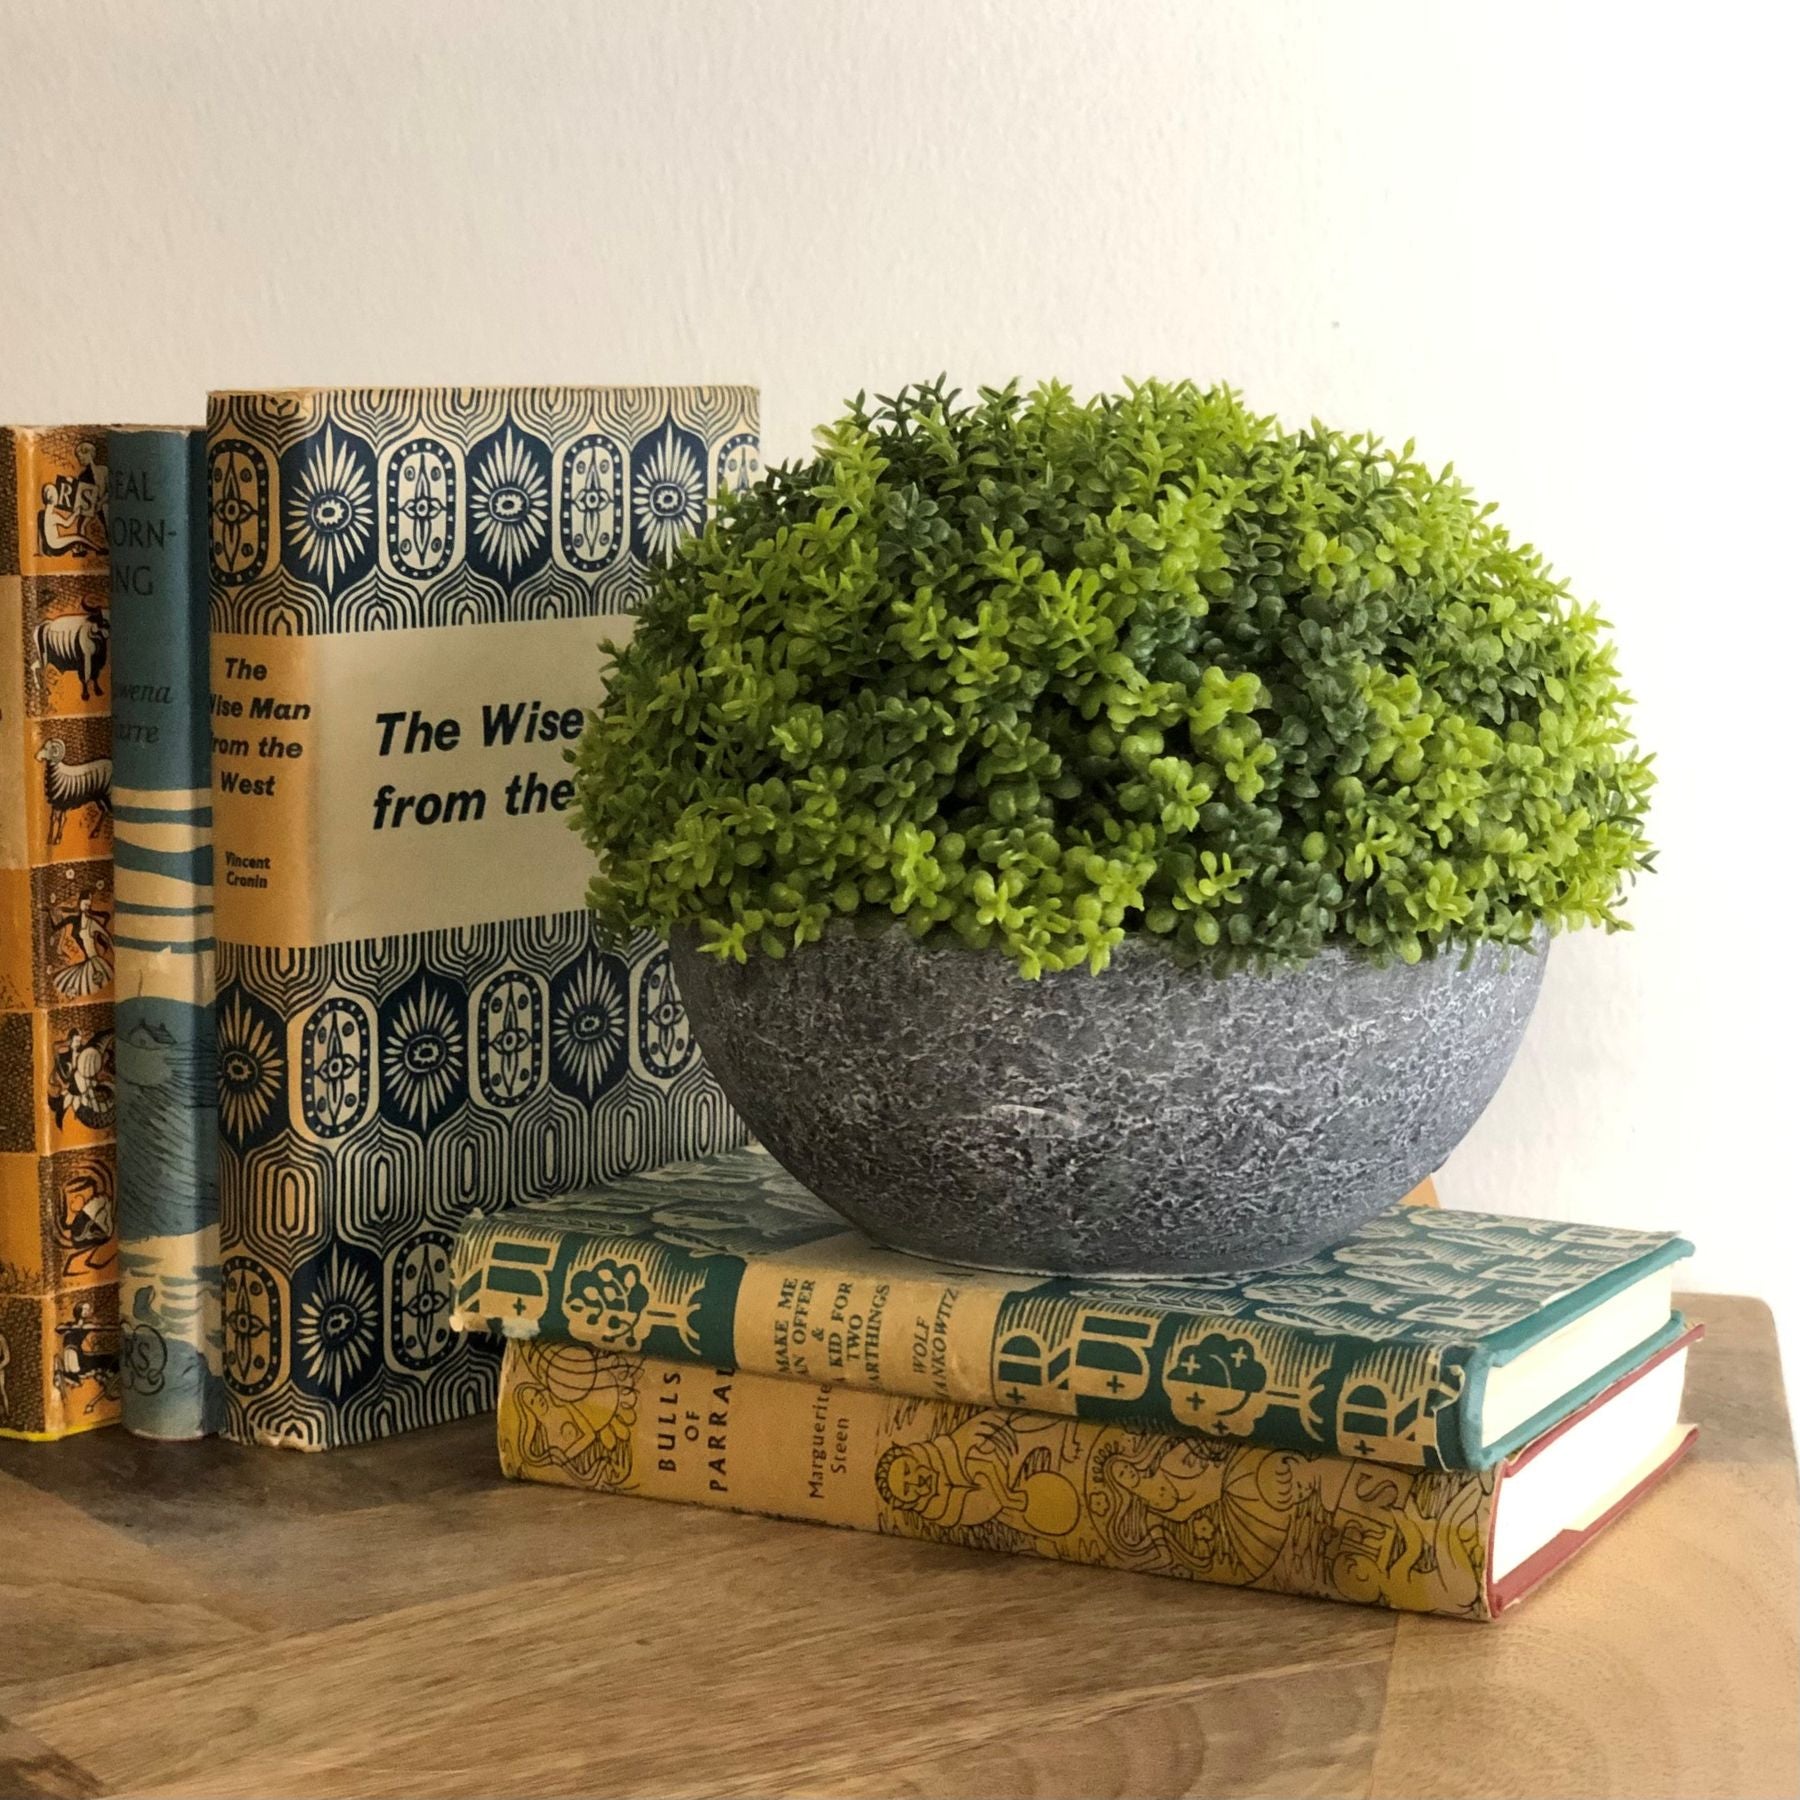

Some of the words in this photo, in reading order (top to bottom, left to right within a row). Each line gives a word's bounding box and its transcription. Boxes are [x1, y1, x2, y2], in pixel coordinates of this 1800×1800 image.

[111, 470, 154, 502] EAL
[111, 517, 176, 549] ORN-
[112, 563, 153, 596] NG
[225, 657, 268, 681] The
[249, 697, 312, 721] Man
[211, 731, 250, 757] rom
[258, 736, 304, 759] the
[376, 710, 461, 756] The
[482, 701, 585, 747] Wise
[220, 771, 276, 796] West
[373, 784, 487, 830] from
[505, 772, 575, 816] the
[225, 851, 271, 869] Vincent
[226, 871, 268, 889] Cronin
[777, 1278, 799, 1310] ME
[792, 1279, 816, 1345] OFFER
[832, 1282, 853, 1323] FOR
[774, 1319, 790, 1375] MAKE
[811, 1326, 825, 1342] &
[828, 1331, 844, 1368] KID
[846, 1313, 864, 1361] TWO
[864, 1284, 891, 1388] ARTHINGS
[912, 1316, 931, 1374] WOLF
[657, 1372, 681, 1473] BULLS
[684, 1410, 700, 1442] OF
[707, 1367, 736, 1492] PARRAL
[808, 1384, 833, 1500] Marguerite
[830, 1417, 850, 1474] Steen
